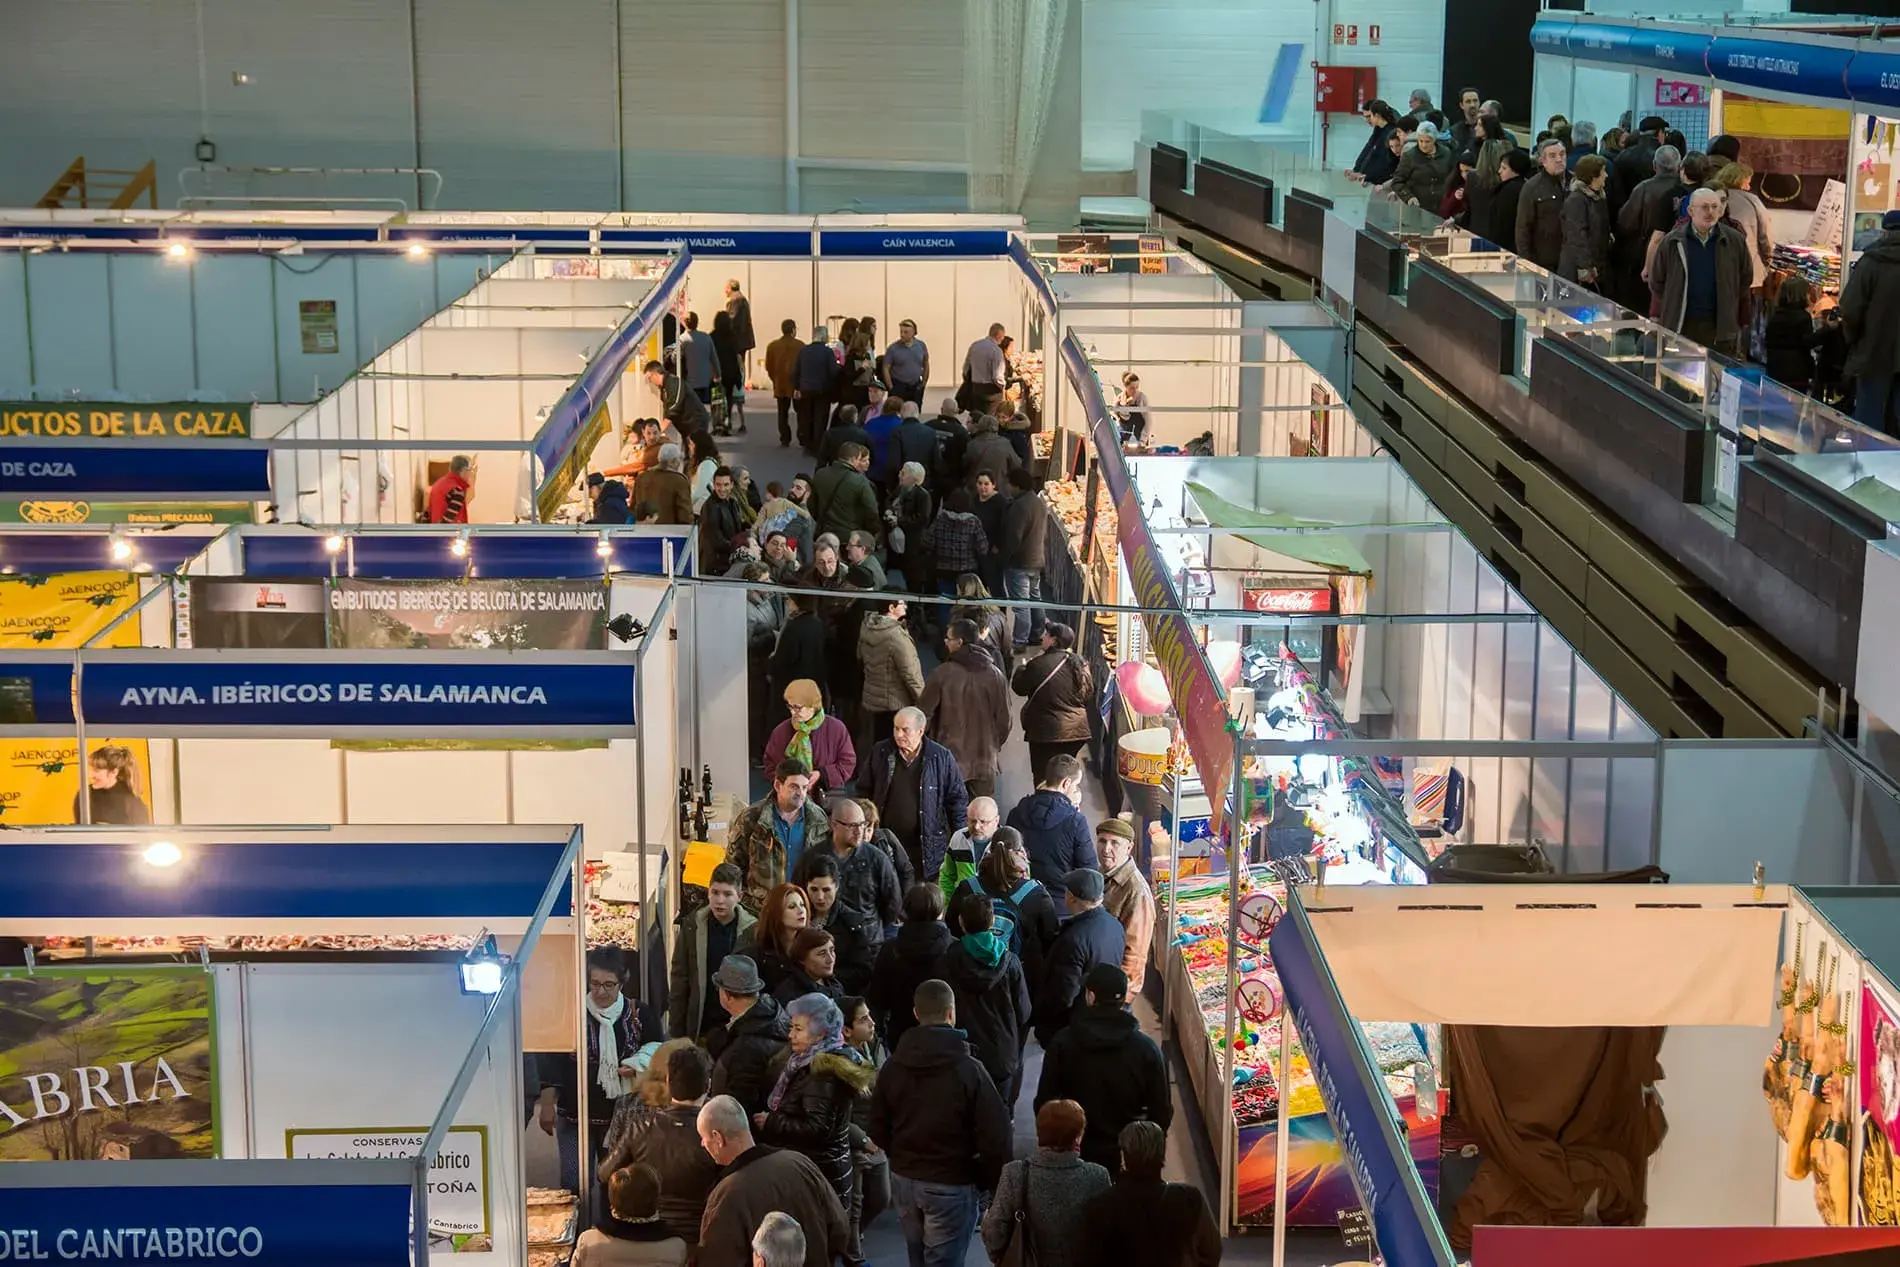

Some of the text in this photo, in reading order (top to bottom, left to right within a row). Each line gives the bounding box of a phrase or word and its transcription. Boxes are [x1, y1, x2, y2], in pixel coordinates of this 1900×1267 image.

[689, 238, 736, 247] VALENCIA
[908, 238, 955, 247] VALENCIA
[89, 412, 125, 436] DE
[133, 412, 167, 435] LA
[173, 412, 246, 436] CAZA
[2, 462, 76, 477] DE CAZA
[331, 590, 397, 611] EMBUTIDOS
[453, 592, 469, 610] DE
[470, 592, 519, 611] BELLOTA
[521, 592, 536, 611] DE
[538, 592, 606, 611] SALAMANCA
[1, 616, 71, 628] JAENCOOP
[120, 681, 548, 706] AYNA. IBÉRICOS DE SALAMANCA
[353, 1137, 423, 1147] CONSERVAS
[56, 1226, 263, 1260] CANTABRICO
